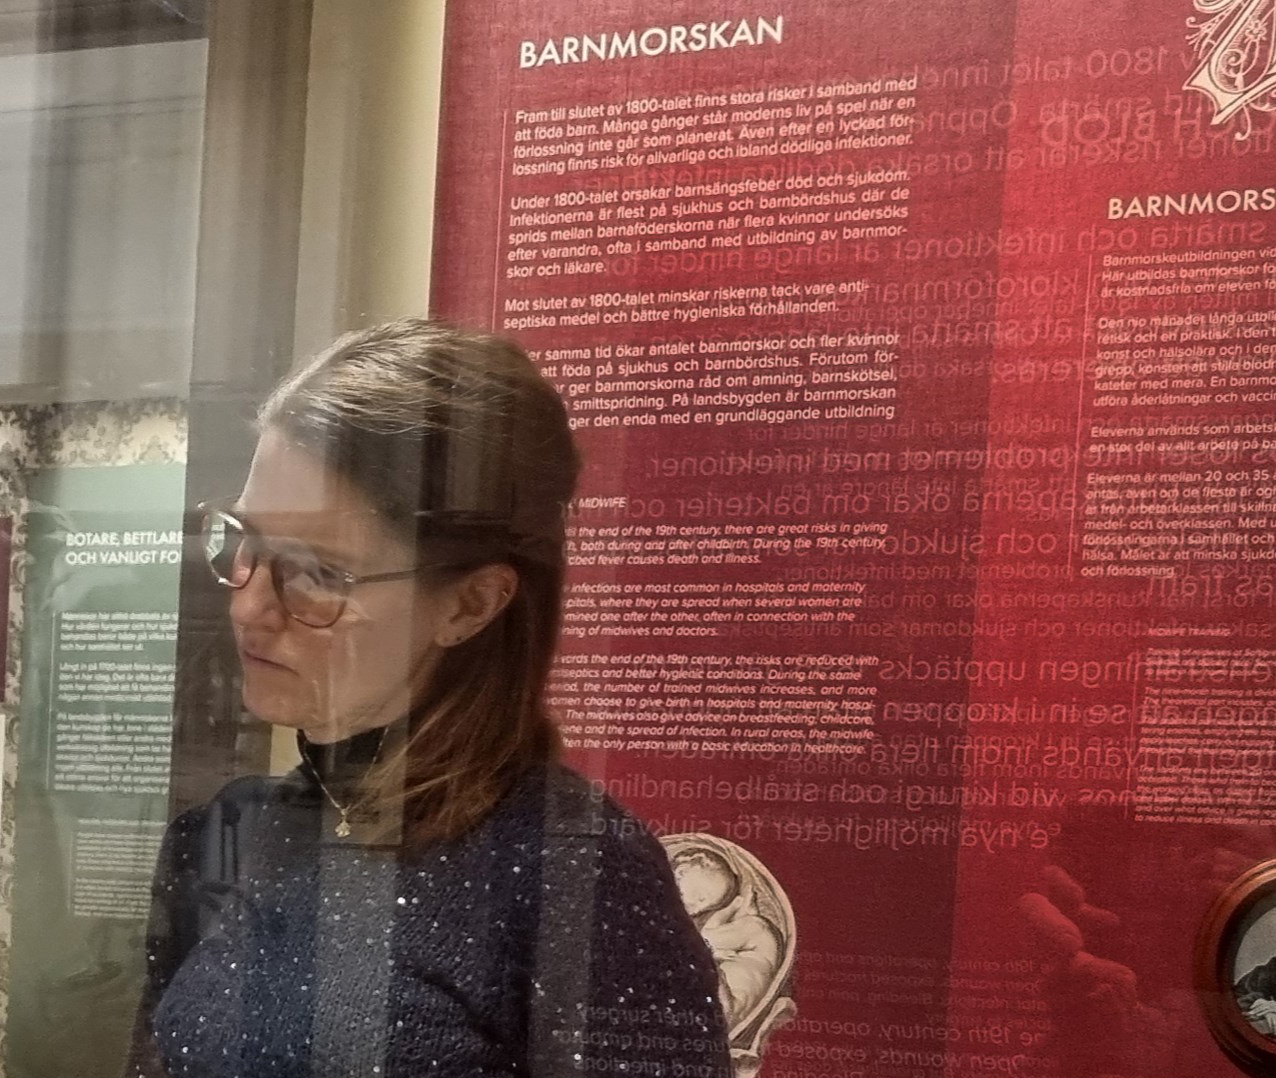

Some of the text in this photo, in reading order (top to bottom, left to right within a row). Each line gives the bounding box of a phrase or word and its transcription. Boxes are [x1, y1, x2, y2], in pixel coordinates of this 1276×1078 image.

[520, 16, 783, 69] BARNMORSKAN
[515, 110, 547, 124] Fram
[550, 107, 565, 121] till
[568, 103, 604, 119] slutet
[606, 105, 622, 116] av
[626, 96, 691, 114] 1800-talet
[694, 95, 726, 109] finns
[729, 92, 764, 106] stora
[767, 88, 805, 103] risker
[816, 80, 881, 99] samband
[884, 77, 917, 93] med
[513, 141, 583, 158] förlossning
[588, 138, 612, 152] inte
[616, 136, 639, 153] går
[643, 136, 671, 148] som
[739, 127, 774, 140] Även
[778, 123, 812, 137] efter
[815, 124, 834, 135] en
[839, 116, 885, 135] lyckad
[514, 127, 531, 141] att
[534, 125, 563, 139] föda
[602, 119, 647, 134] Många
[651, 116, 698, 133] gånger
[702, 111, 727, 126] står
[731, 108, 792, 123] moderns
[795, 105, 811, 118] liv
[814, 102, 832, 119] på
[836, 100, 866, 117] spel
[869, 98, 893, 112] när
[896, 99, 915, 110] en
[512, 160, 565, 175] lossning
[567, 158, 598, 171] finns
[600, 154, 623, 169] risk
[625, 153, 644, 167] för
[646, 149, 705, 165] allvarliga
[707, 146, 733, 161] och
[735, 143, 777, 159] ibland
[780, 140, 832, 155] dödliga
[509, 187, 909, 227] Infektionerna är flest på sjukhus och barnbördshus där de
[510, 195, 549, 210] Under
[554, 189, 618, 207] 1800-talet
[621, 187, 670, 202] orsakar
[674, 179, 781, 198] barnsängsfeber
[785, 176, 812, 190] död
[816, 174, 843, 188] och
[1108, 188, 1276, 219] BARNMORS
[504, 298, 529, 312] Mot
[532, 296, 567, 311] slutet
[570, 299, 586, 309] av
[590, 292, 654, 308] 1800-talet
[657, 289, 709, 304] minskar
[713, 287, 767, 301] riskerna
[771, 284, 800, 298] tack
[804, 285, 834, 296] vare
[503, 314, 556, 331] septiska
[559, 311, 599, 326] medel
[602, 310, 627, 324] och
[630, 308, 669, 322] bättre
[673, 304, 745, 323] hygieniska
[579, 497, 627, 509] MIDWIFE
[65, 551, 98, 565] OCH
[99, 551, 157, 565] VANLIGT
